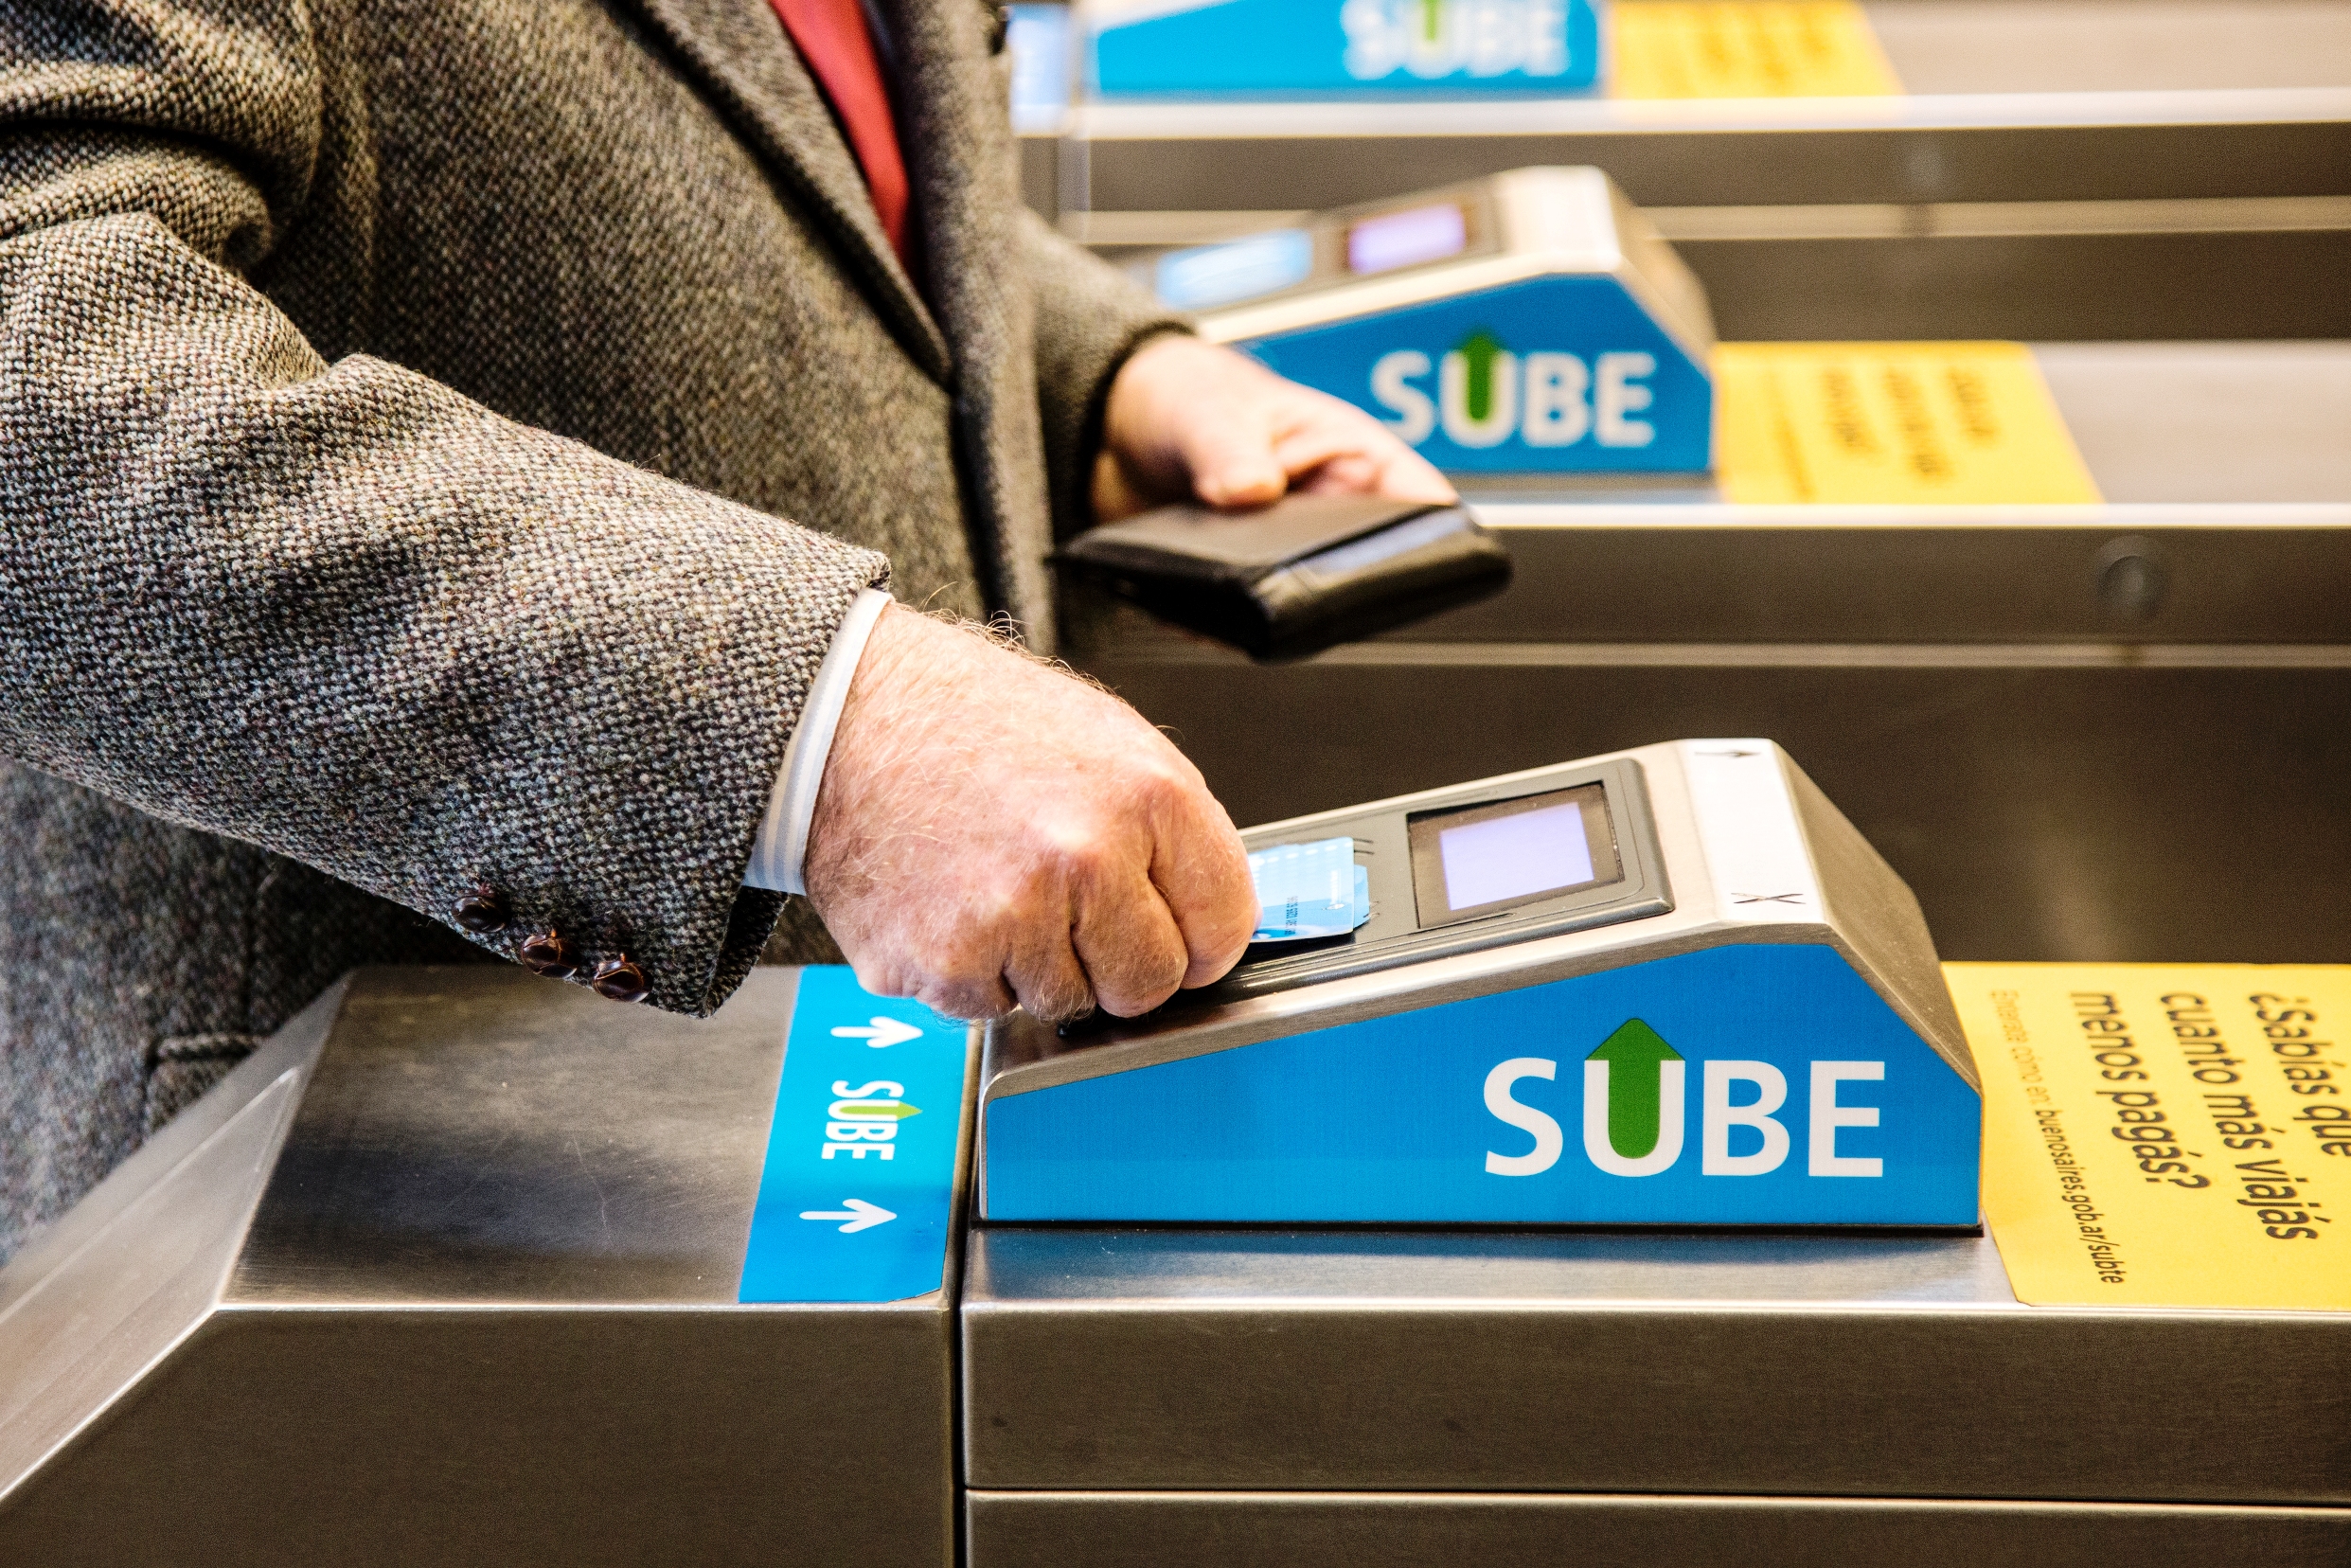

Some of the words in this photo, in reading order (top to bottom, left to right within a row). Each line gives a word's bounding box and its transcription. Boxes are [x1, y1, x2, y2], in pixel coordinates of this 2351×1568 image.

[1370, 348, 1657, 450] SUBE
[2070, 992, 2147, 1080] menos
[2160, 993, 2245, 1084] cuanto
[2250, 993, 2346, 1096] ¿Sabías
[821, 1079, 906, 1161] SUBE
[1484, 1057, 1885, 1177] SUBE
[2095, 1090, 2213, 1189] pagás?
[2202, 1094, 2287, 1149] más
[2292, 1105, 2351, 1156] que
[2035, 1109, 2127, 1284] buenosaires.gob.ar/subte
[2235, 1159, 2332, 1239] viajás
